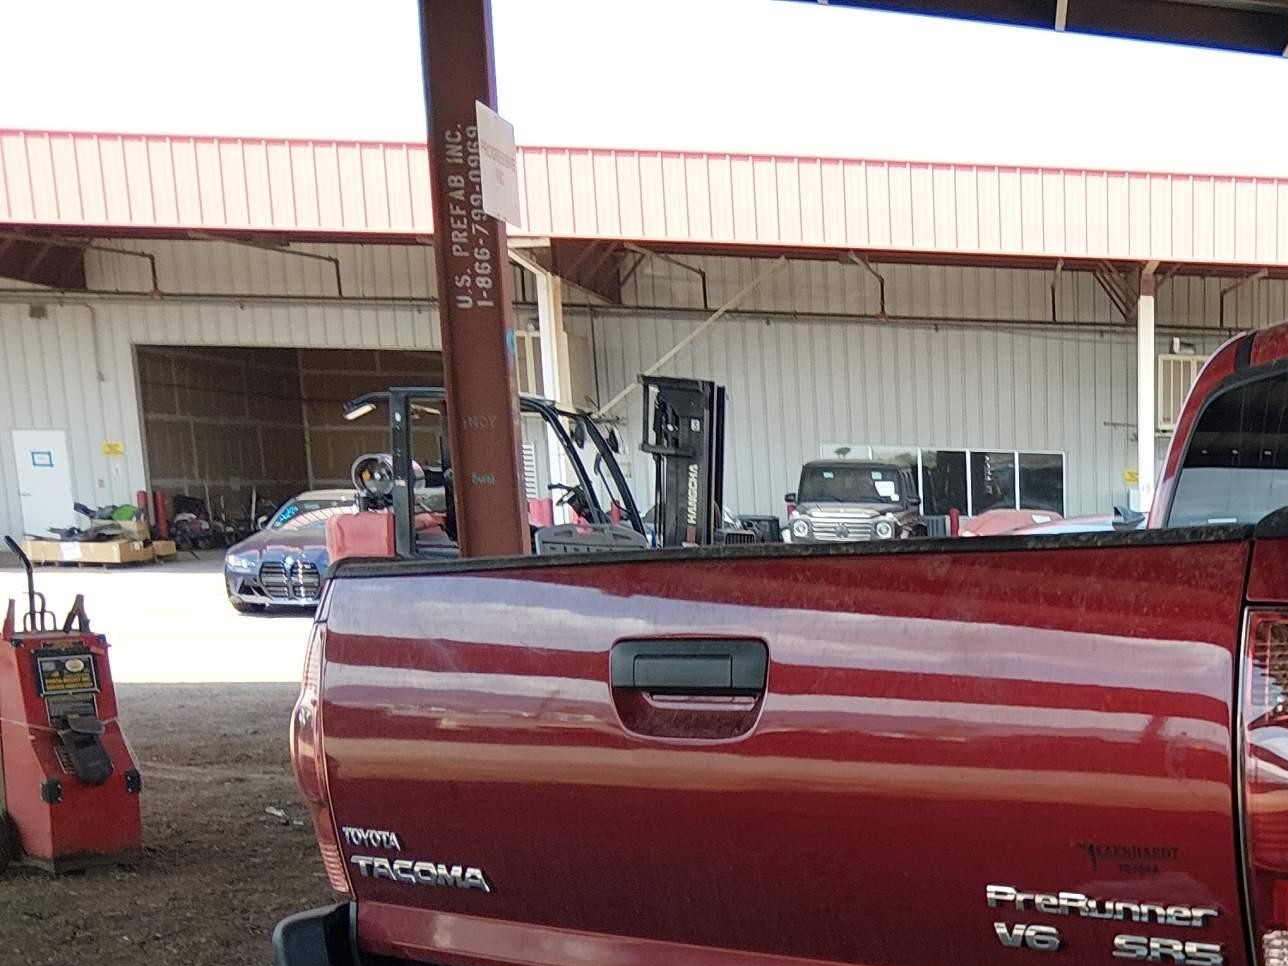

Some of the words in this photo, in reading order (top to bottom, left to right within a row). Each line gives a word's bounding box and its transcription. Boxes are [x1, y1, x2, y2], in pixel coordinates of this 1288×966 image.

[444, 123, 464, 164] INC.
[447, 174, 470, 257] PREFAB
[455, 269, 474, 309] U.S.
[687, 464, 699, 525] HANGCHA
[342, 826, 401, 851] TOYOTA
[350, 854, 491, 894] TACOMA
[986, 884, 1219, 928] PreRunner
[993, 921, 1061, 951] V6
